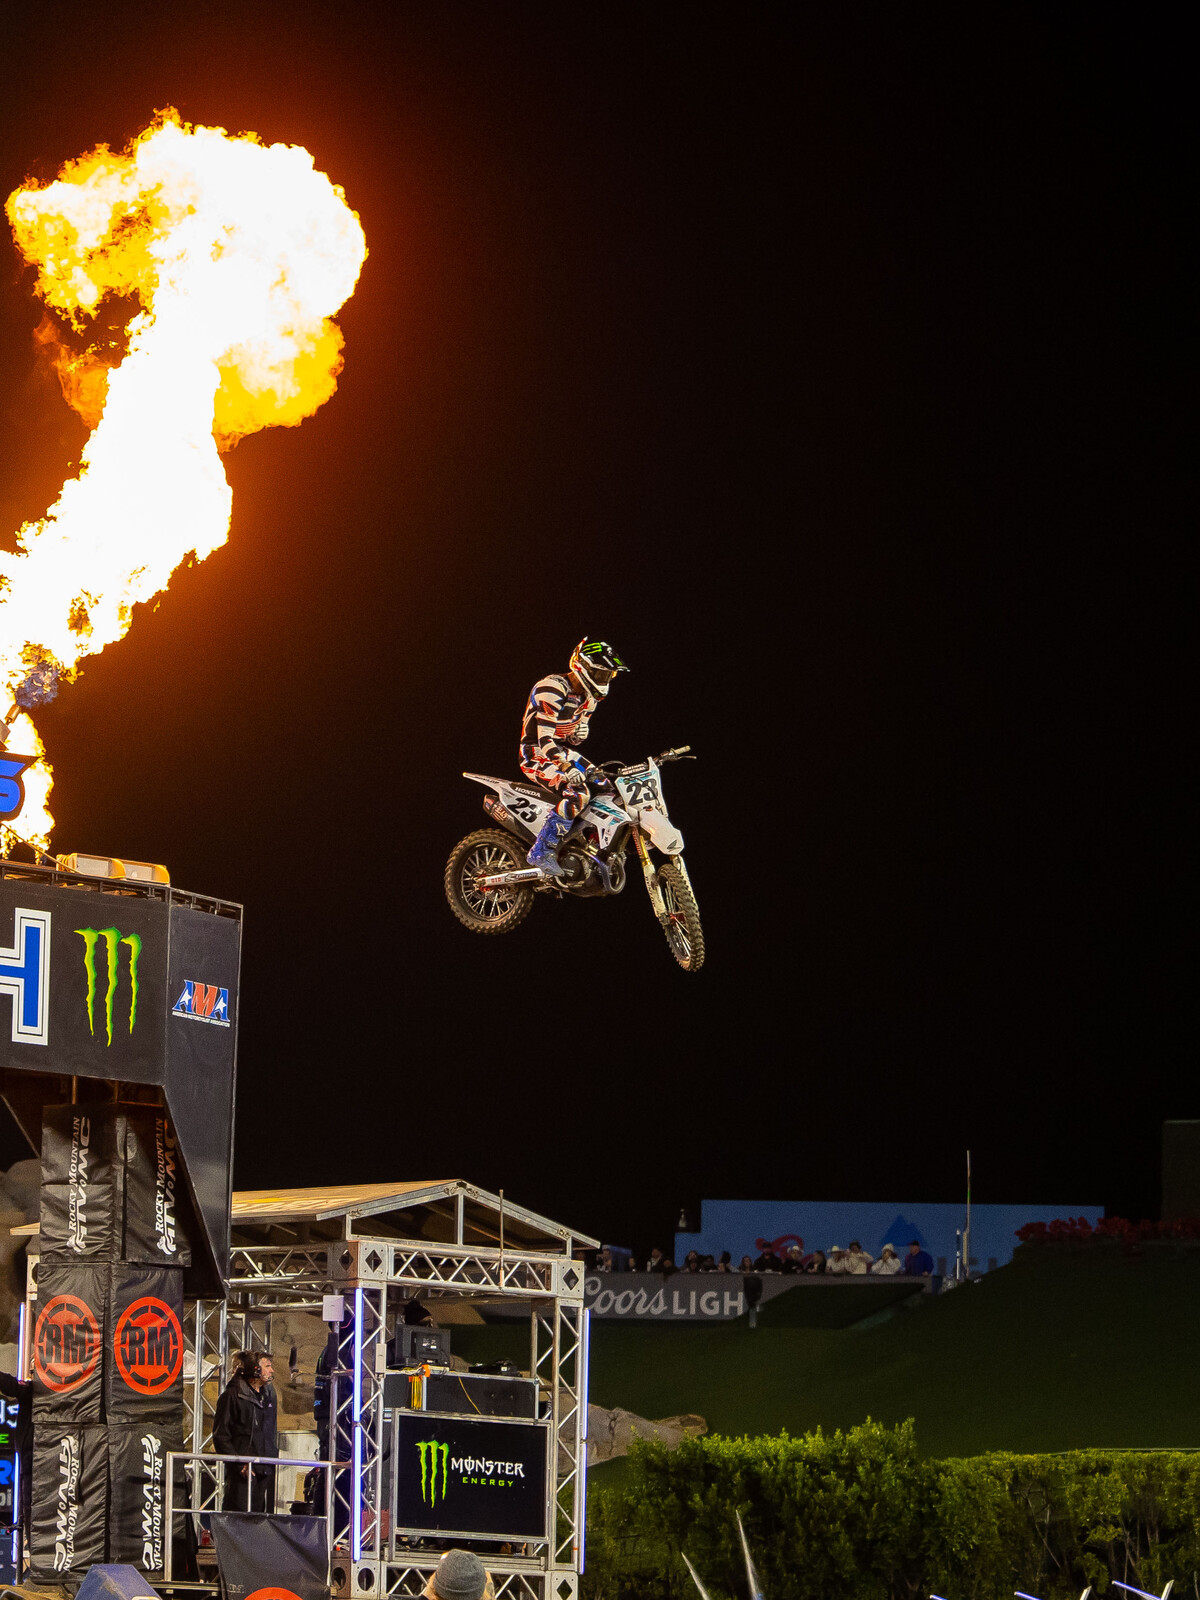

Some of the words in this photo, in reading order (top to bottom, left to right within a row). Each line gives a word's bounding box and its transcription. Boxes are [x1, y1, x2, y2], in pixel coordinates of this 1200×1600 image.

[507, 797, 539, 823] 23
[514, 786, 541, 798] HONDA
[626, 778, 658, 806] 23
[171, 979, 231, 1022] AMA
[68, 1116, 81, 1188] MOUNTAIN
[155, 1117, 166, 1189] MOUNTAIN
[68, 1189, 77, 1232] ROCKY
[155, 1189, 165, 1233] ROCKY
[673, 1290, 744, 1315] LIGH
[67, 1457, 80, 1501] ROCKY
[153, 1455, 163, 1501] ROCKY
[462, 1476, 514, 1487] ENERGY
[63, 1502, 78, 1572] MOUNTAIN
[152, 1501, 163, 1571] MOUNTAIN
